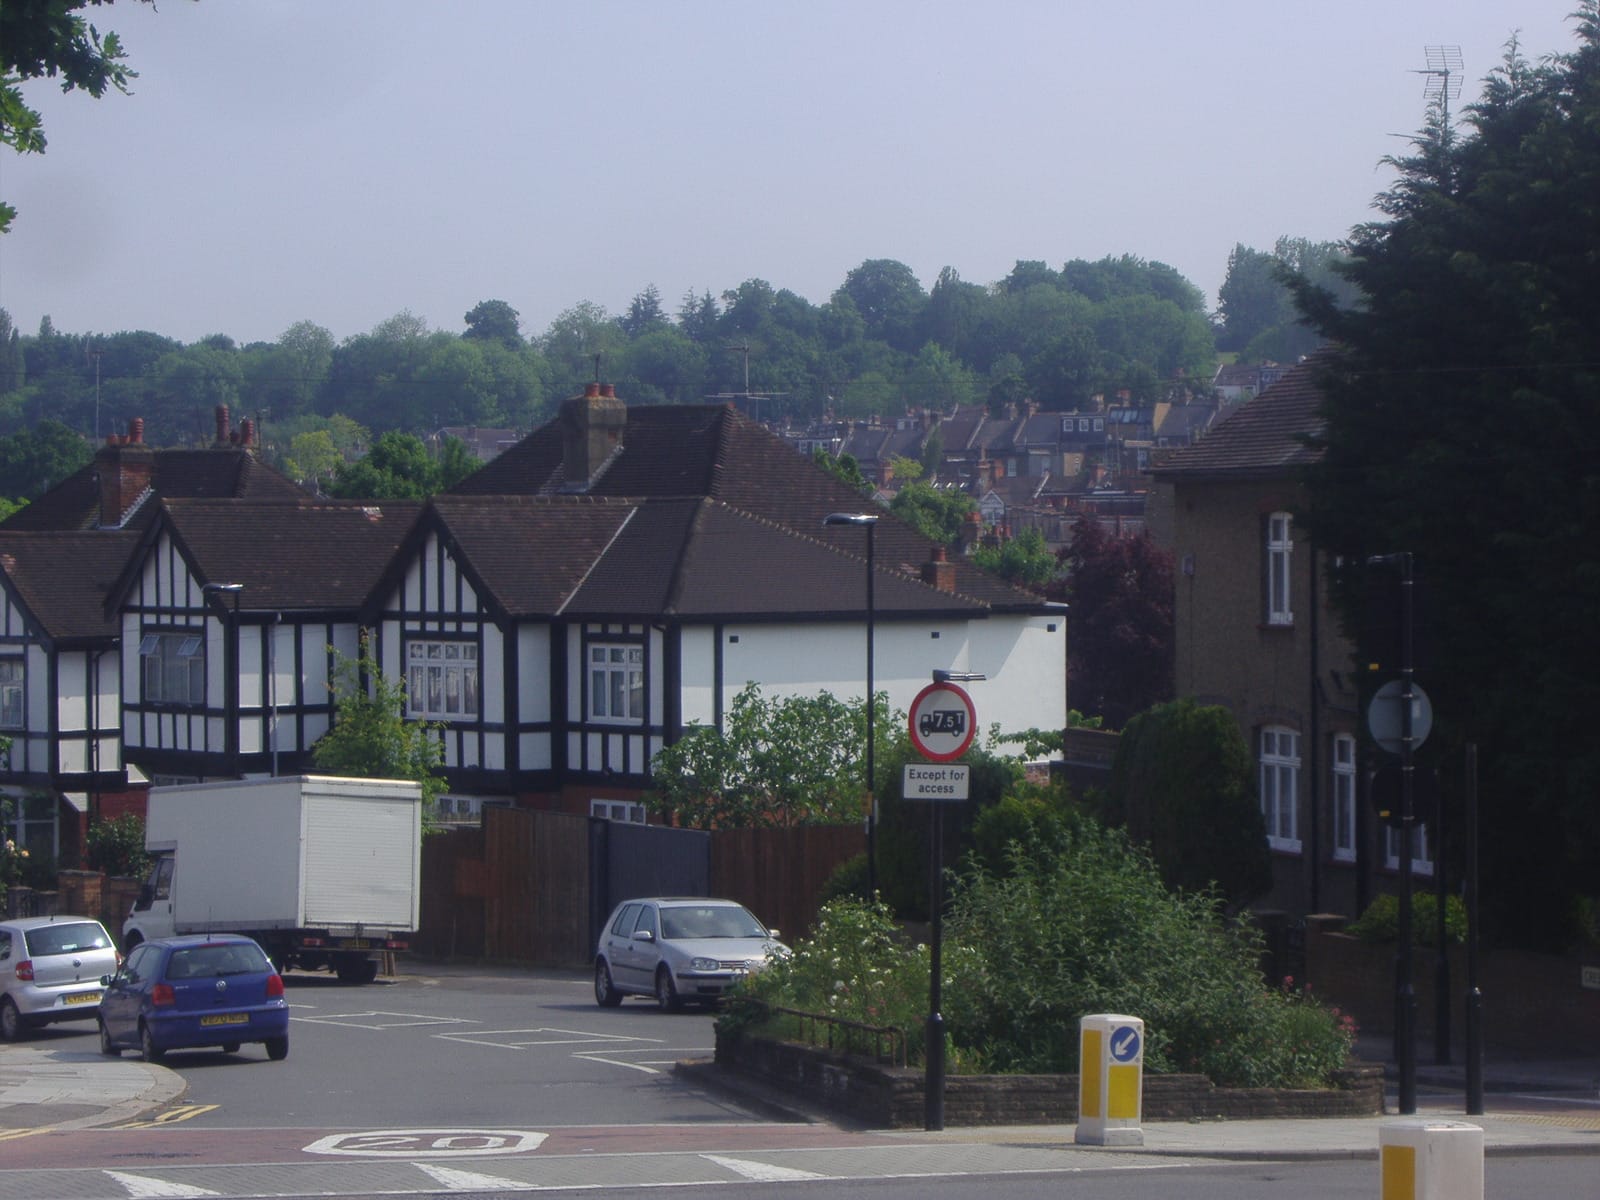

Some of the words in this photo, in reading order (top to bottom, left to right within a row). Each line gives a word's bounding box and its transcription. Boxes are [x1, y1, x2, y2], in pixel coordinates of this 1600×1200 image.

[908, 768, 946, 781] Except
[950, 769, 965, 780] for
[918, 785, 954, 794] access
[341, 1136, 507, 1150] 20
